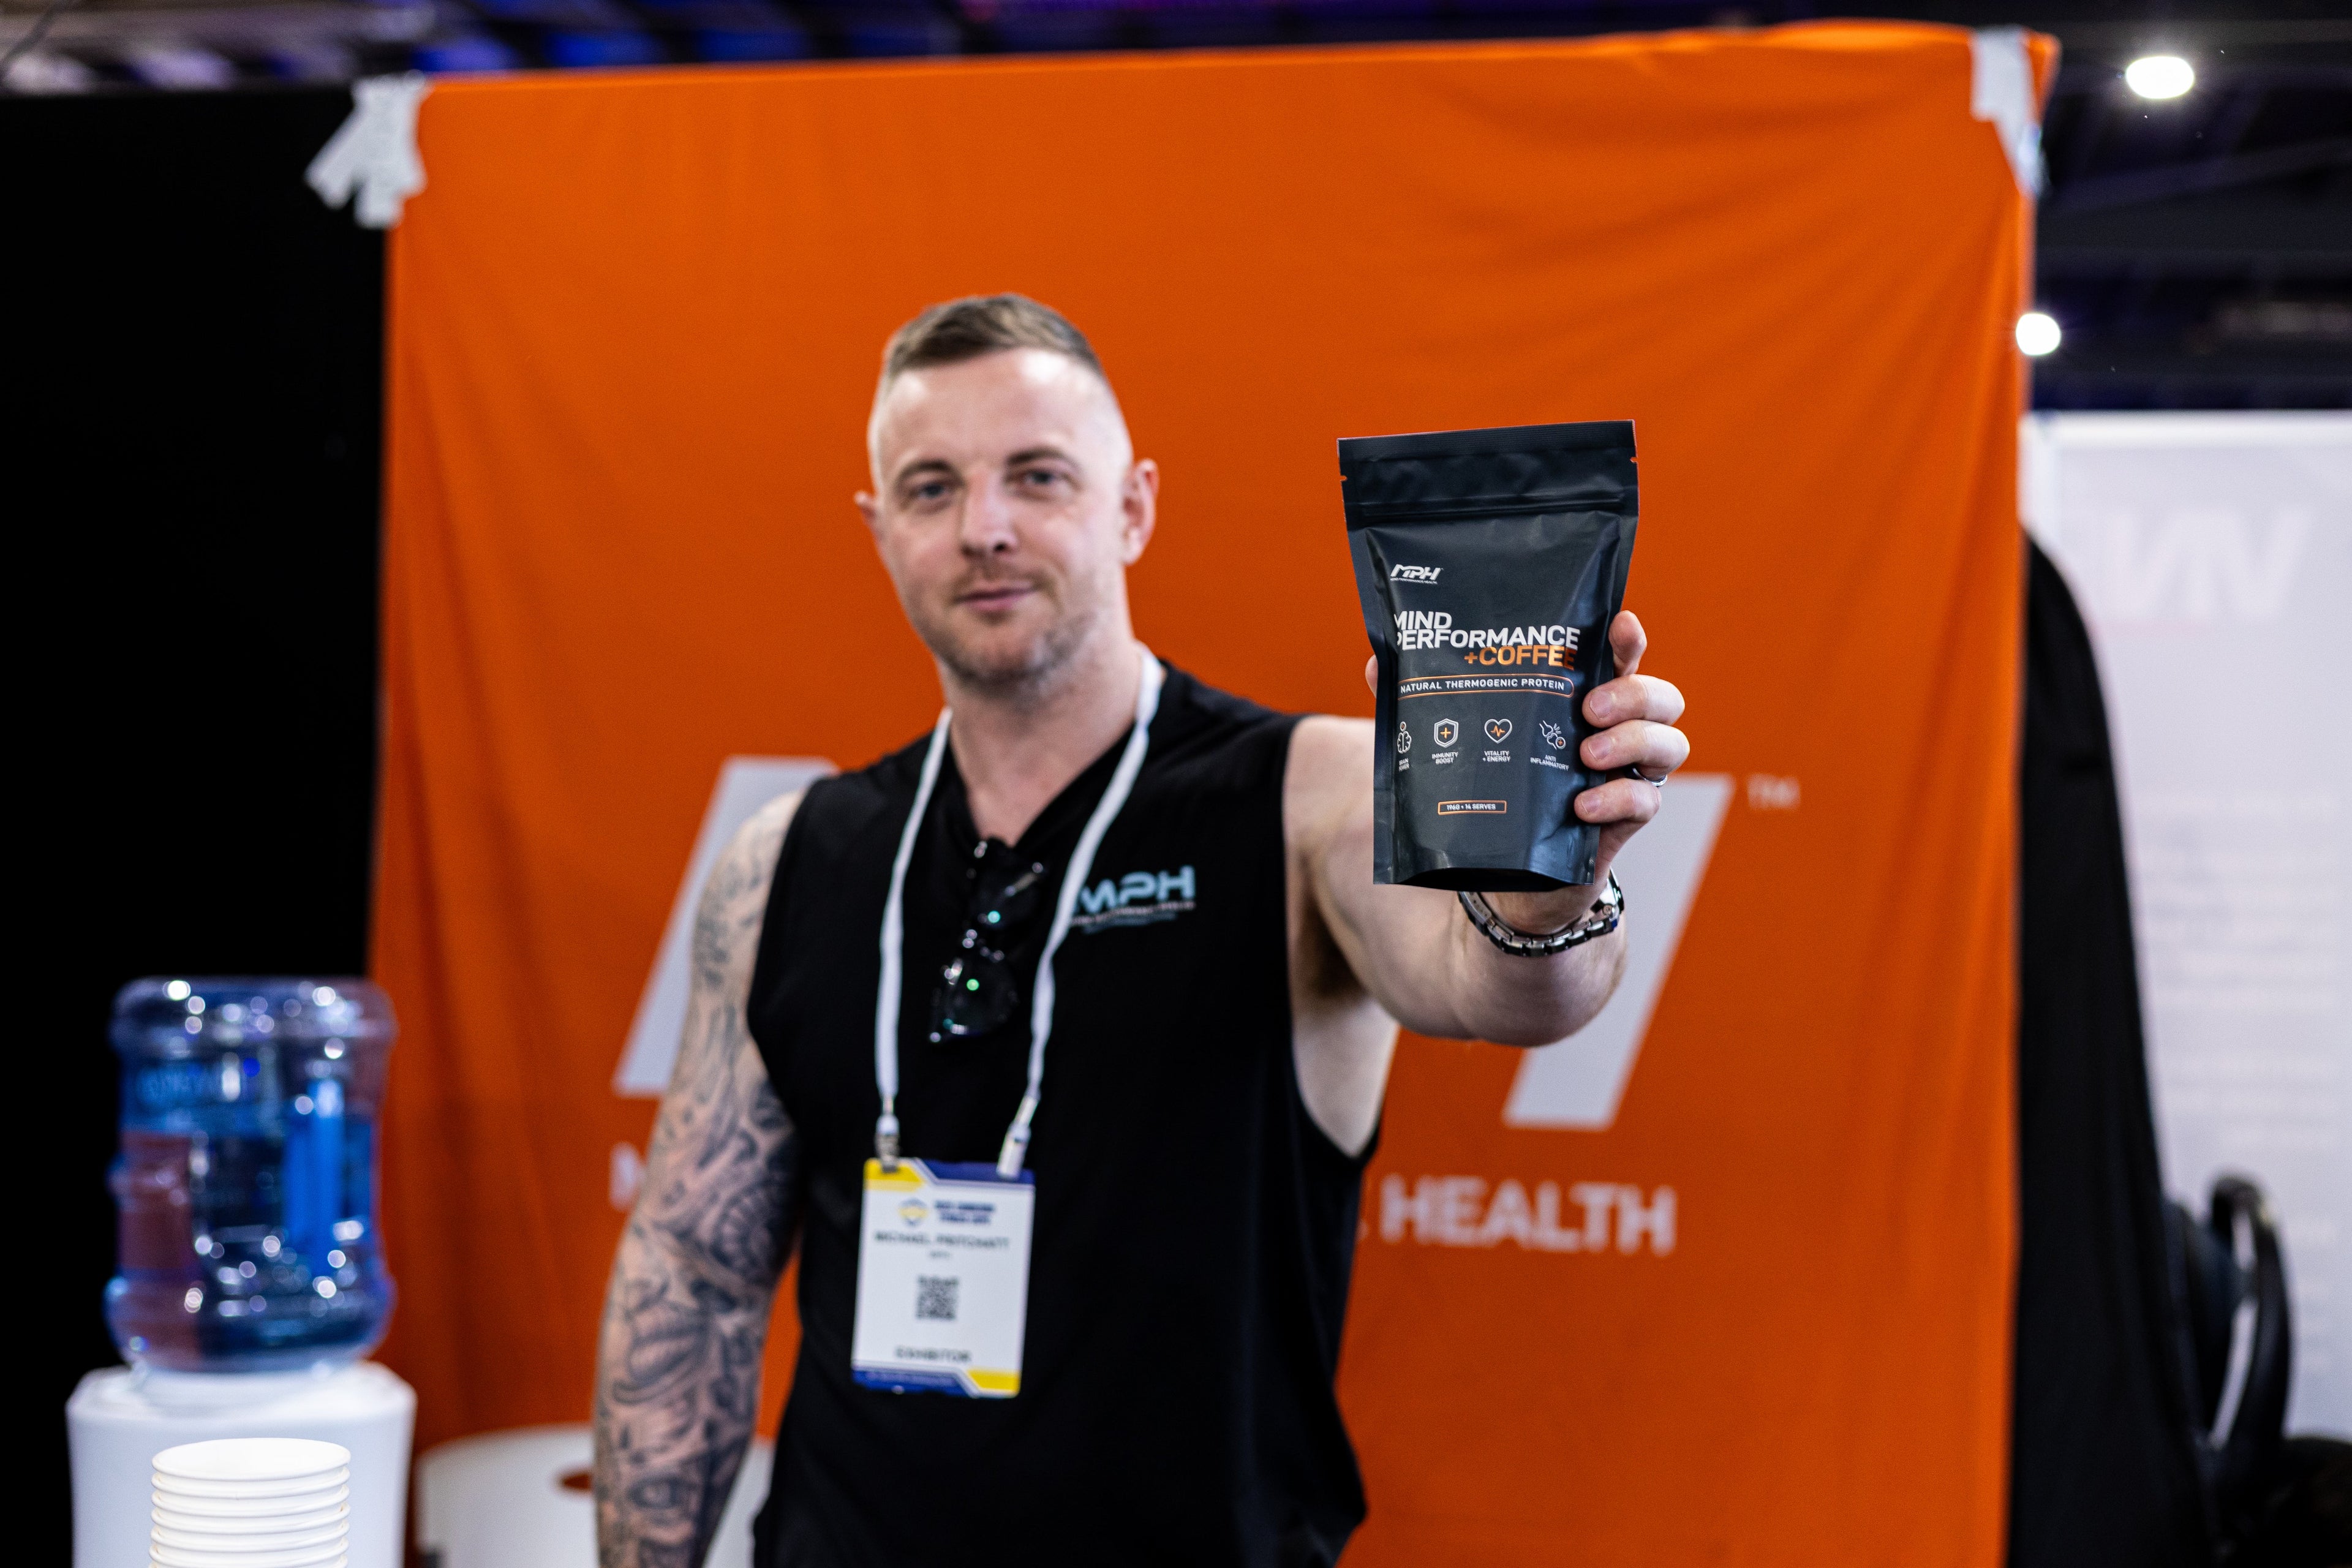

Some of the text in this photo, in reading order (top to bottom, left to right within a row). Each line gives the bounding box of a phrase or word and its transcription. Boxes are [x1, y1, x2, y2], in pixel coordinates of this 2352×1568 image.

[1390, 564, 1441, 581] MPH
[1393, 611, 1452, 630] MIND
[1464, 644, 1577, 671] +COFFEE
[1400, 678, 1564, 693] NATURAL THERMOGENIC PROTEIN
[1379, 1172, 1678, 1257] HEALTH
